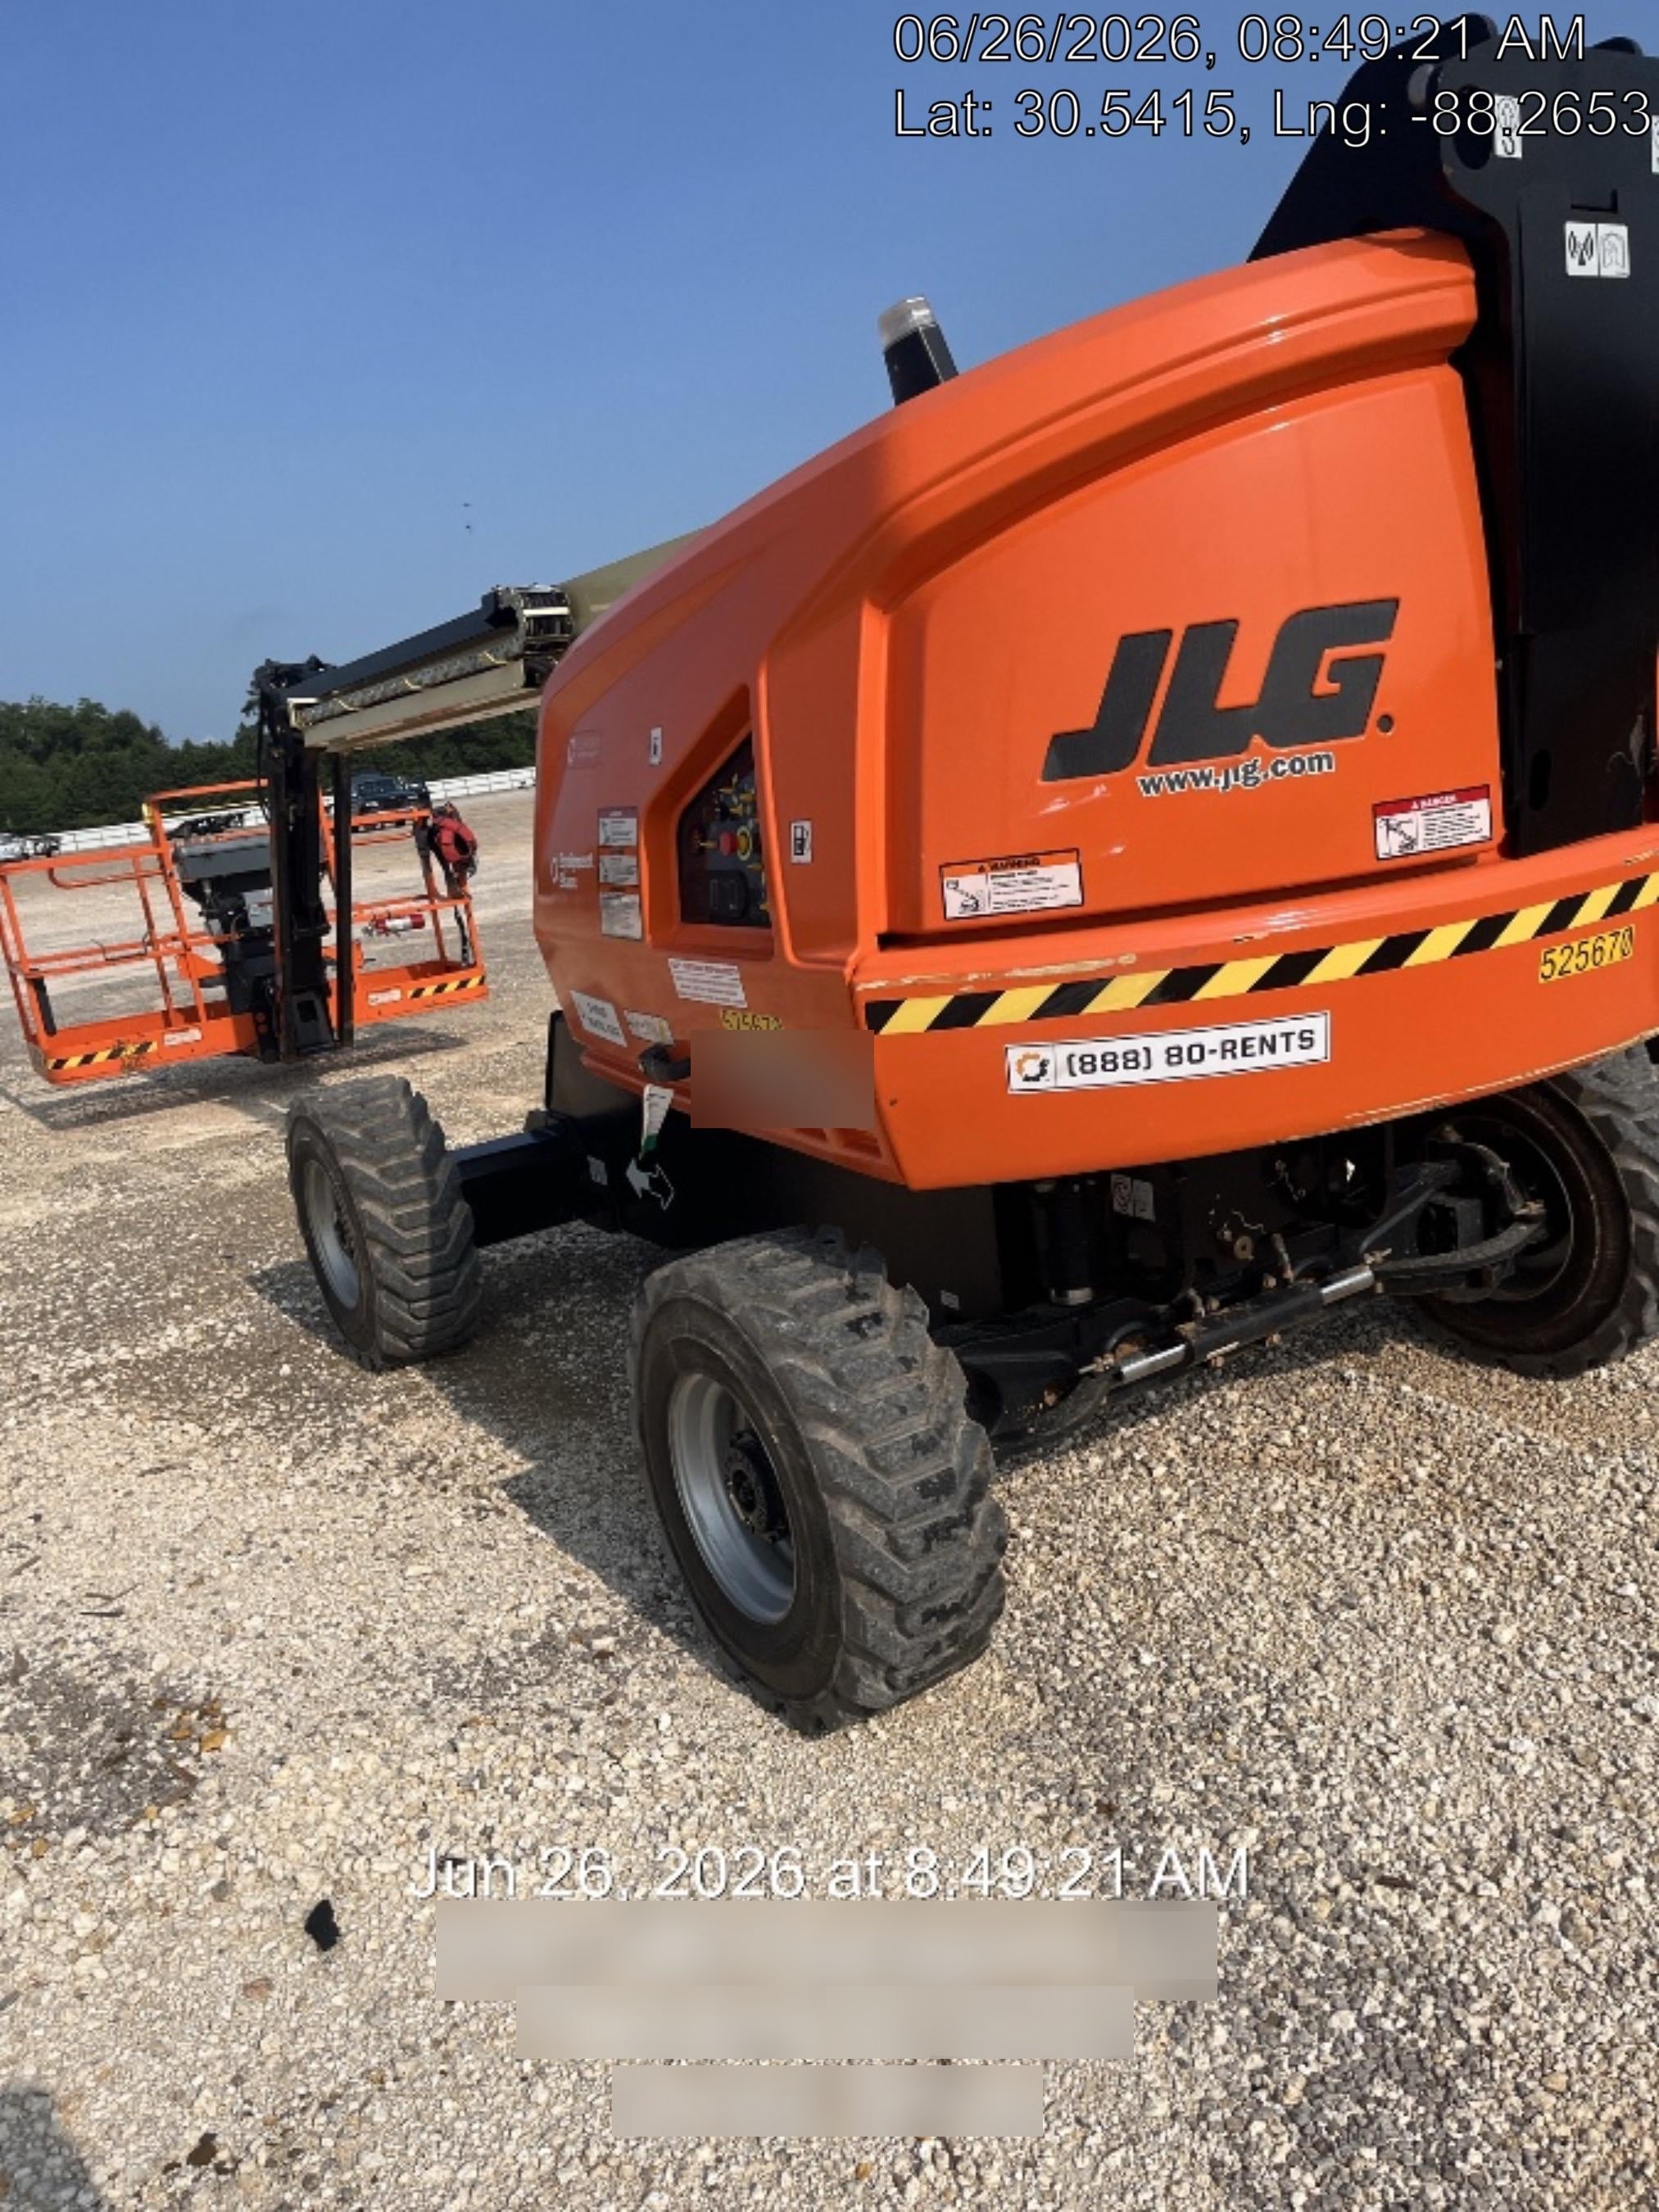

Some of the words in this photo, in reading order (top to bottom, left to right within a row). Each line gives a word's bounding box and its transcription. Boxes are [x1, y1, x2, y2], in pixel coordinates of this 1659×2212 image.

[1539, 926, 1634, 981] 525670
[1067, 1046, 1152, 1077] (888)
[1164, 1029, 1316, 1067] 80-RENTS
